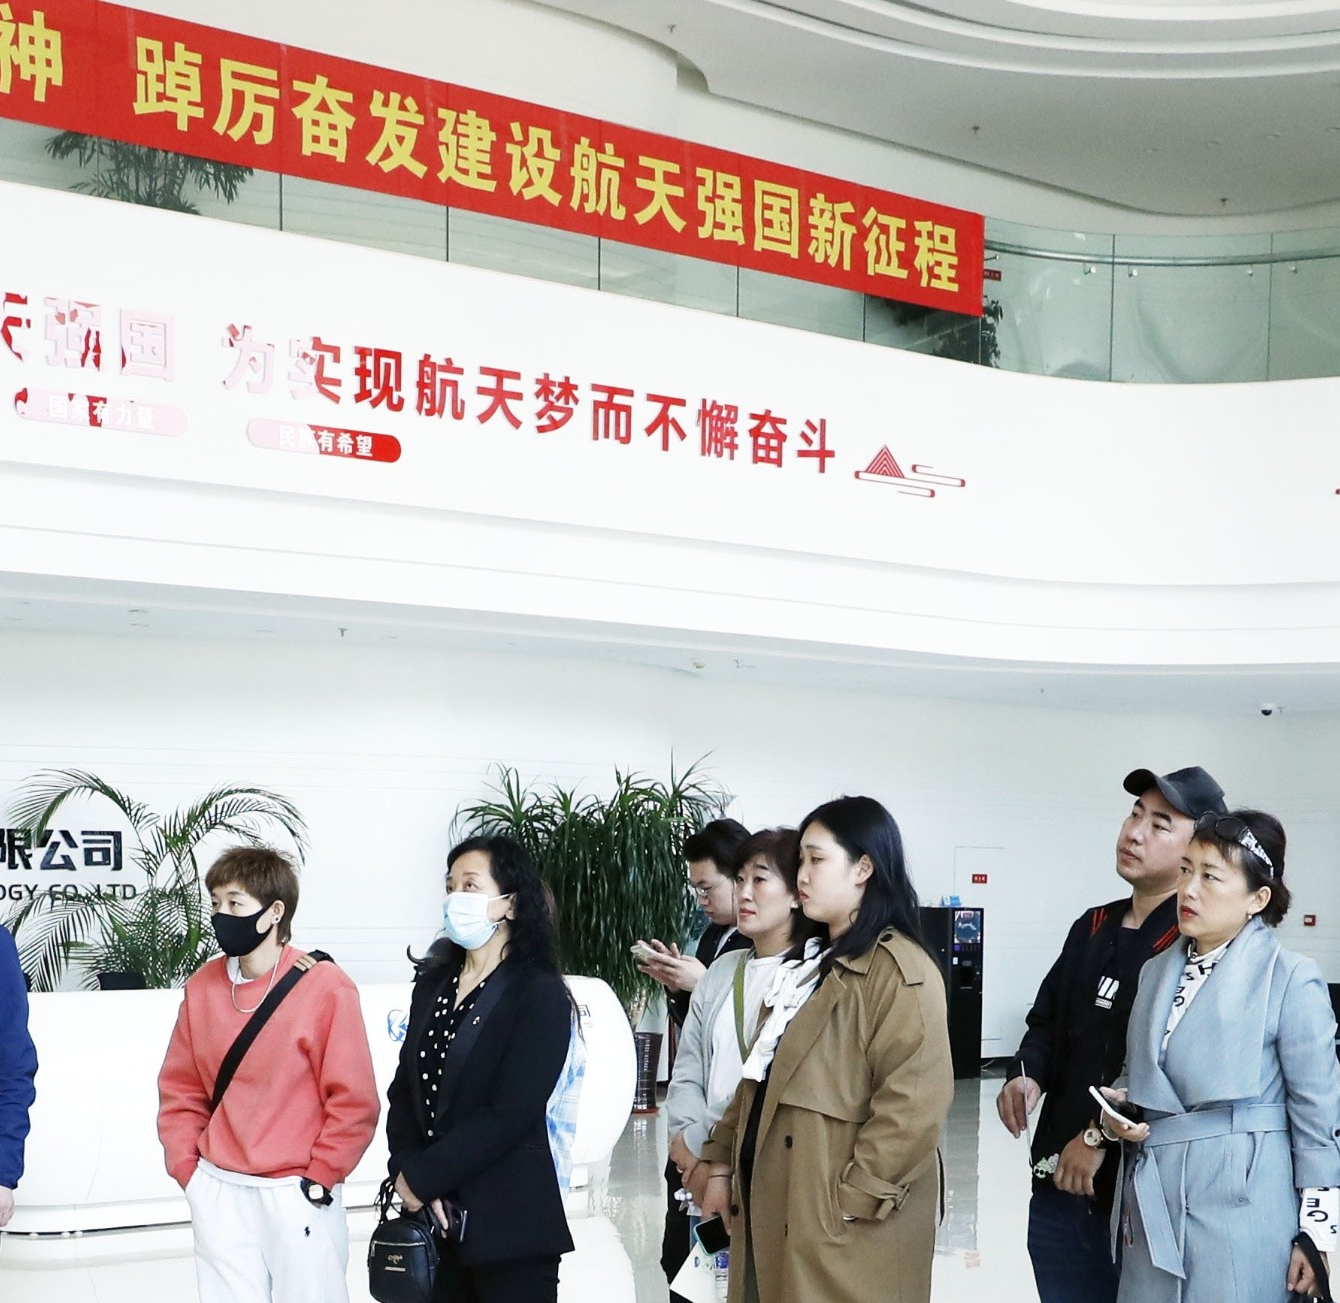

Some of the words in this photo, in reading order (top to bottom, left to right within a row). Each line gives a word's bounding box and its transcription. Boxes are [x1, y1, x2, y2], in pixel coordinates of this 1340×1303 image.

[133, 36, 960, 293] 踔厉奋发建设航天强国新征程
[220, 322, 837, 475] 为实现航天梦而不懈奋斗
[278, 425, 375, 457] 民族有希望
